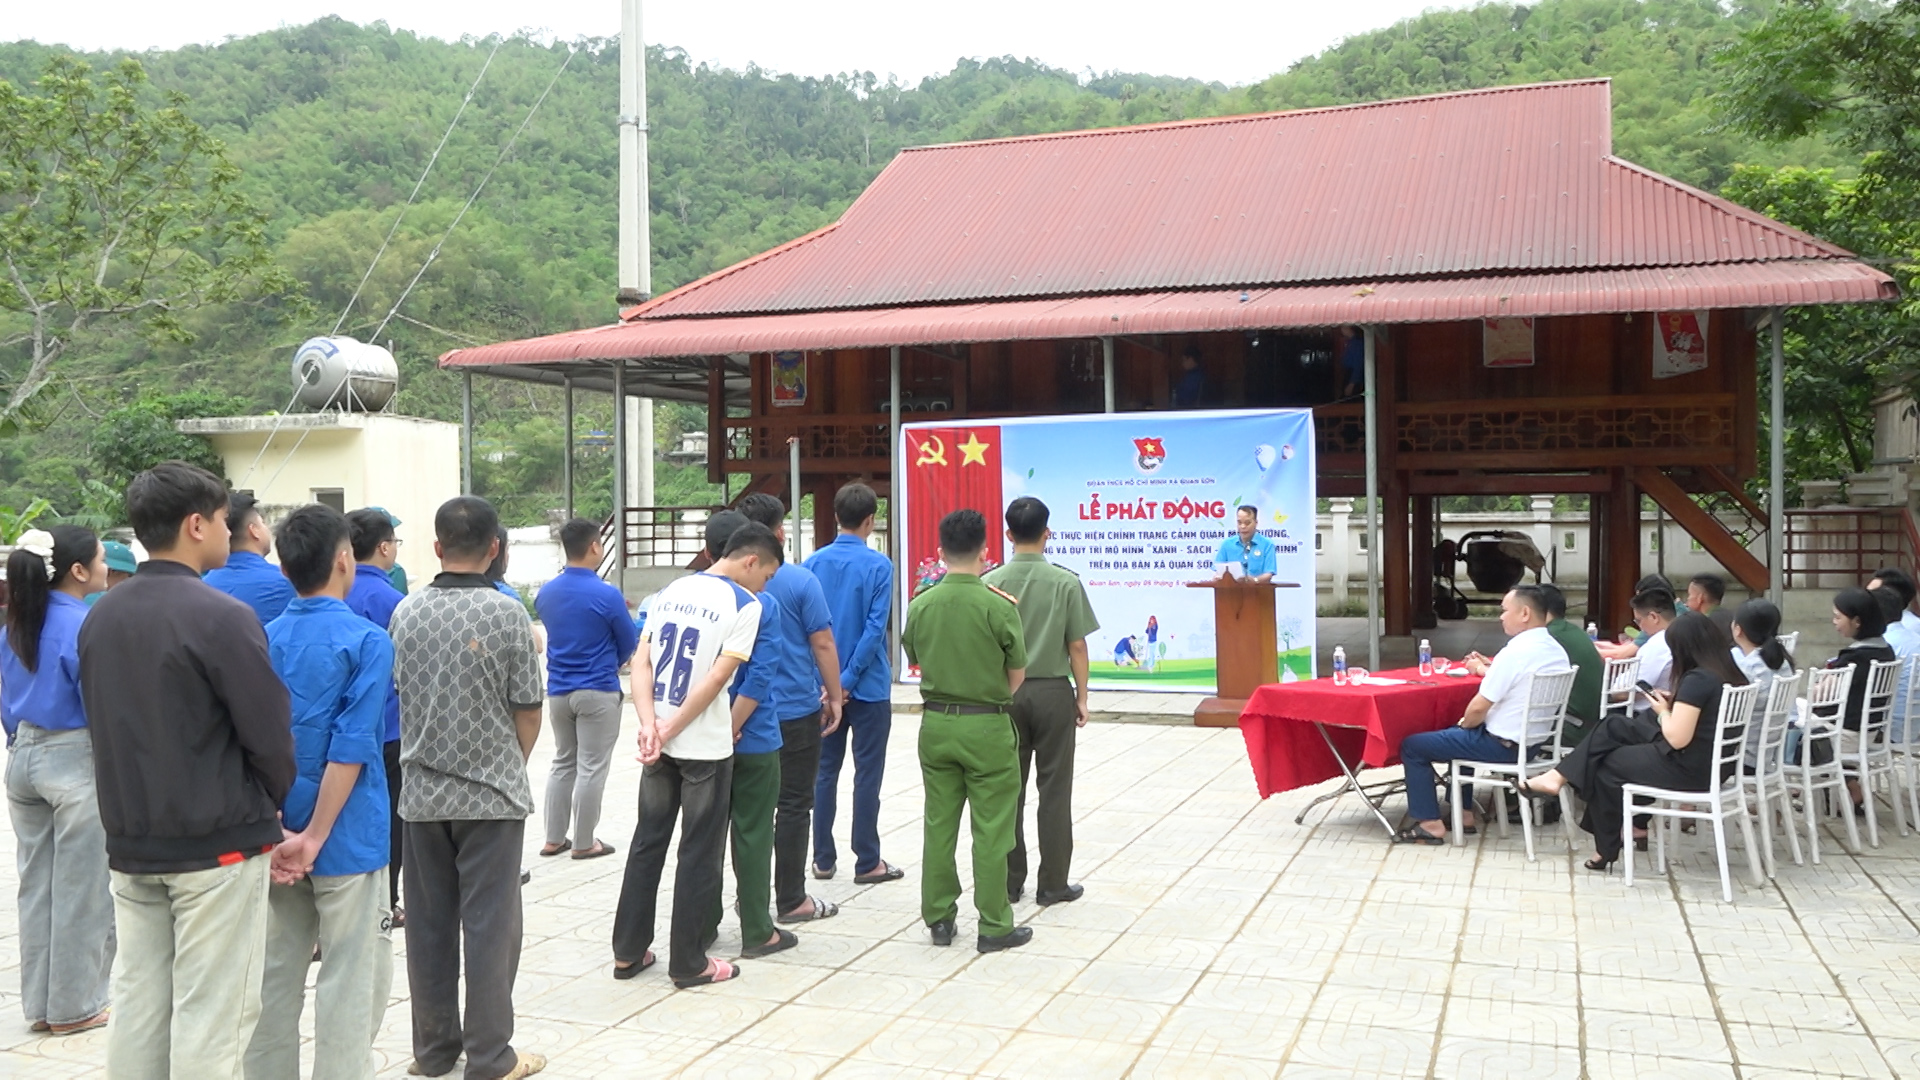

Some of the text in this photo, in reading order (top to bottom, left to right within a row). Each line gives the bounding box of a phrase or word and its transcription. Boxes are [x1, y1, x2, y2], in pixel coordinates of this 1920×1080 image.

[1079, 493, 1226, 524] LỄ PHÁT ĐỘNG
[1060, 530, 1082, 542] THỰC
[1084, 529, 1105, 541] HIỆN
[1138, 530, 1168, 540] TRANG
[1171, 527, 1197, 539] CẢNH
[1200, 529, 1225, 540] QUAN
[1056, 544, 1067, 554] VÀ
[1089, 543, 1102, 554] TRÌ
[1105, 543, 1119, 555] MÔ
[1122, 543, 1144, 554] HÌNH
[1089, 560, 1111, 570] TRÊN
[1131, 560, 1151, 570] BÀN
[1154, 560, 1165, 570] XÃ
[1169, 560, 1193, 570] QUAN
[701, 607, 720, 623] TỤ
[653, 621, 701, 708] 26
